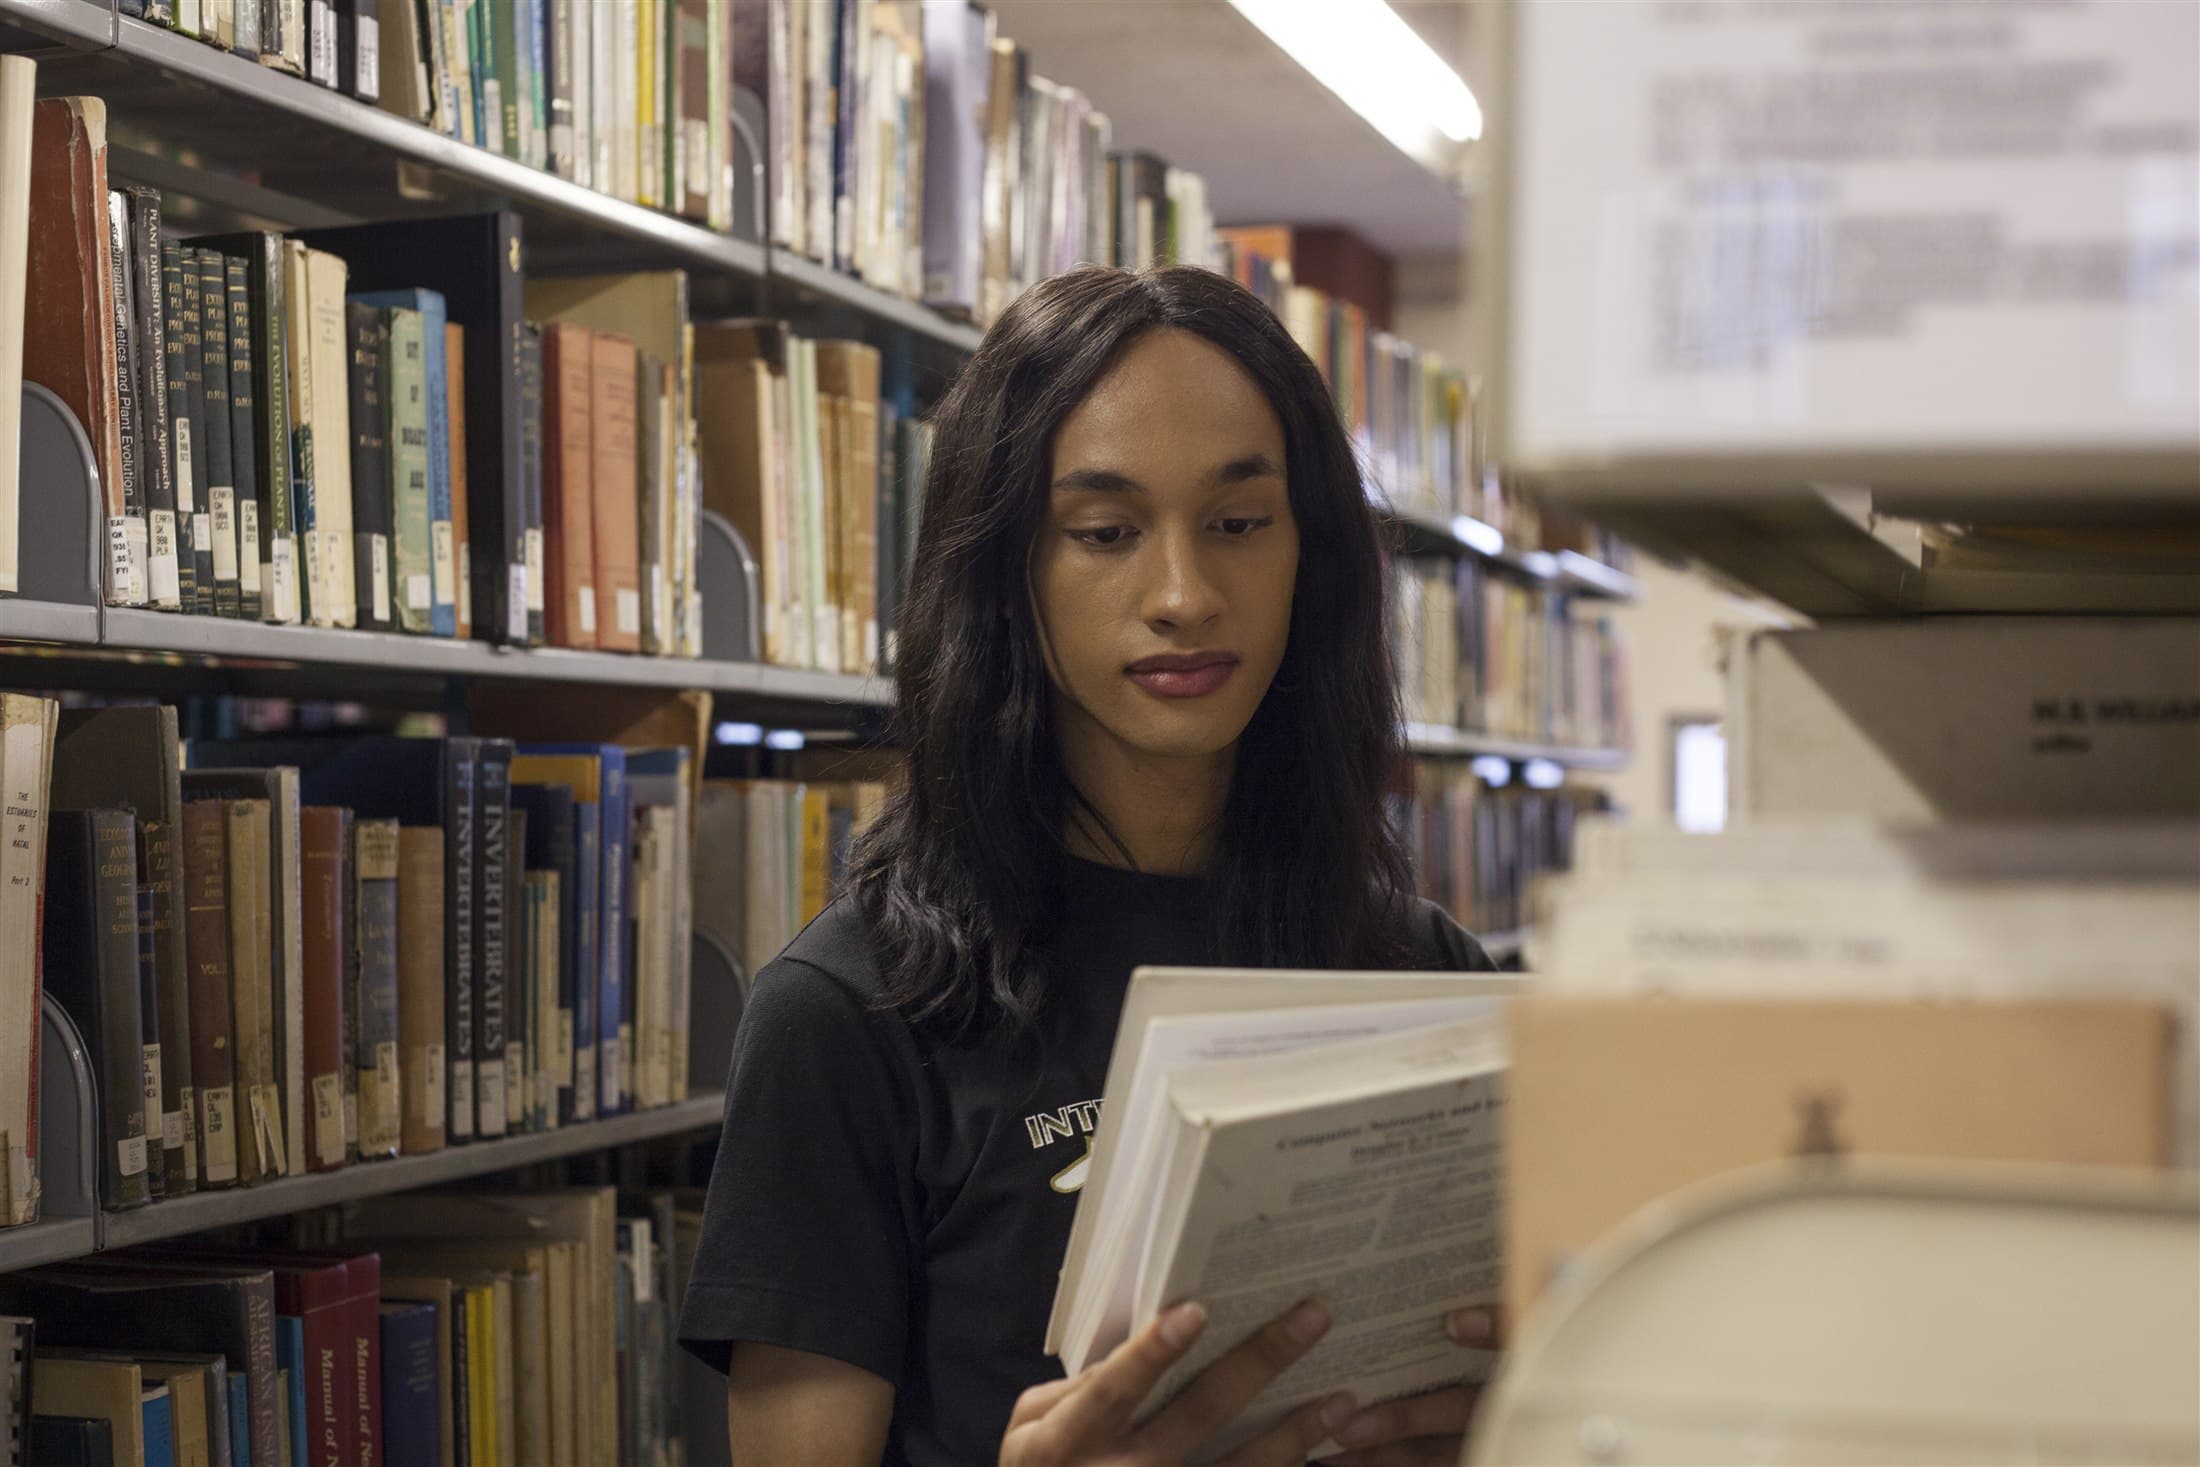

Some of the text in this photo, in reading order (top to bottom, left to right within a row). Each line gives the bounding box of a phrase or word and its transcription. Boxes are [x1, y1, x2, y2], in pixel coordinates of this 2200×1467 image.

[149, 208, 158, 249] PLANT
[150, 254, 161, 323] DIVERSITY:
[115, 303, 127, 363] Genetics
[153, 329, 162, 345] An
[119, 367, 130, 392] and
[155, 349, 166, 425] Evolutionary
[272, 345, 283, 444] EVOLUTION
[120, 397, 134, 431] Plant
[121, 434, 134, 496] Evolution
[158, 430, 171, 490] Approach
[276, 467, 285, 530] PLANTS
[6, 805, 38, 819] ESTUARIES
[18, 791, 29, 801] THE
[12, 839, 30, 850] NATAL
[11, 875, 24, 887] Part
[457, 805, 472, 1055] INVERTEBRATES
[483, 805, 504, 1051] INVERTEBRATES
[256, 1297, 275, 1467] AFRICAN INSE
[357, 1336, 371, 1411] Manual
[321, 1348, 339, 1467] Manual of N
[360, 1415, 373, 1437] of
